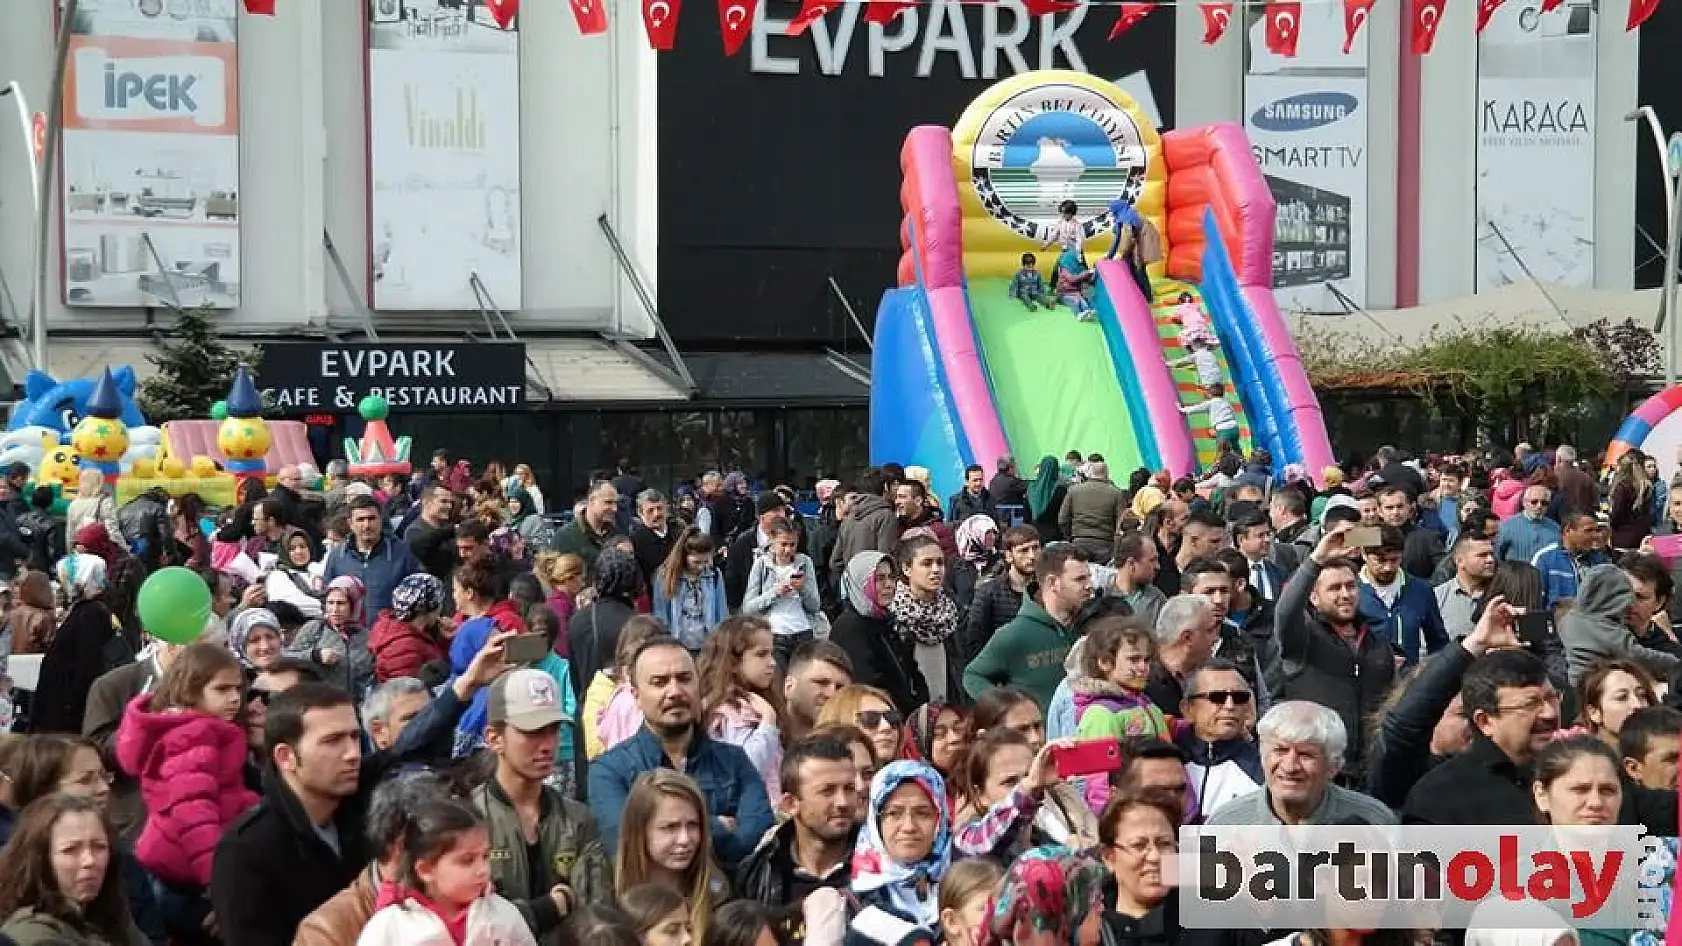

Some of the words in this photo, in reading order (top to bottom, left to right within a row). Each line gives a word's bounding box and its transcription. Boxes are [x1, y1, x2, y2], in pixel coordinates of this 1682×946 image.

[751, 0, 1089, 79] EVPARK
[403, 82, 485, 149] Vinaldi
[1264, 102, 1346, 120] SAMSUNG
[1483, 99, 1587, 133] KARACA
[1252, 145, 1332, 168] SMART
[1336, 146, 1362, 168] TV
[321, 350, 456, 377] EVPARK
[335, 385, 355, 408] &
